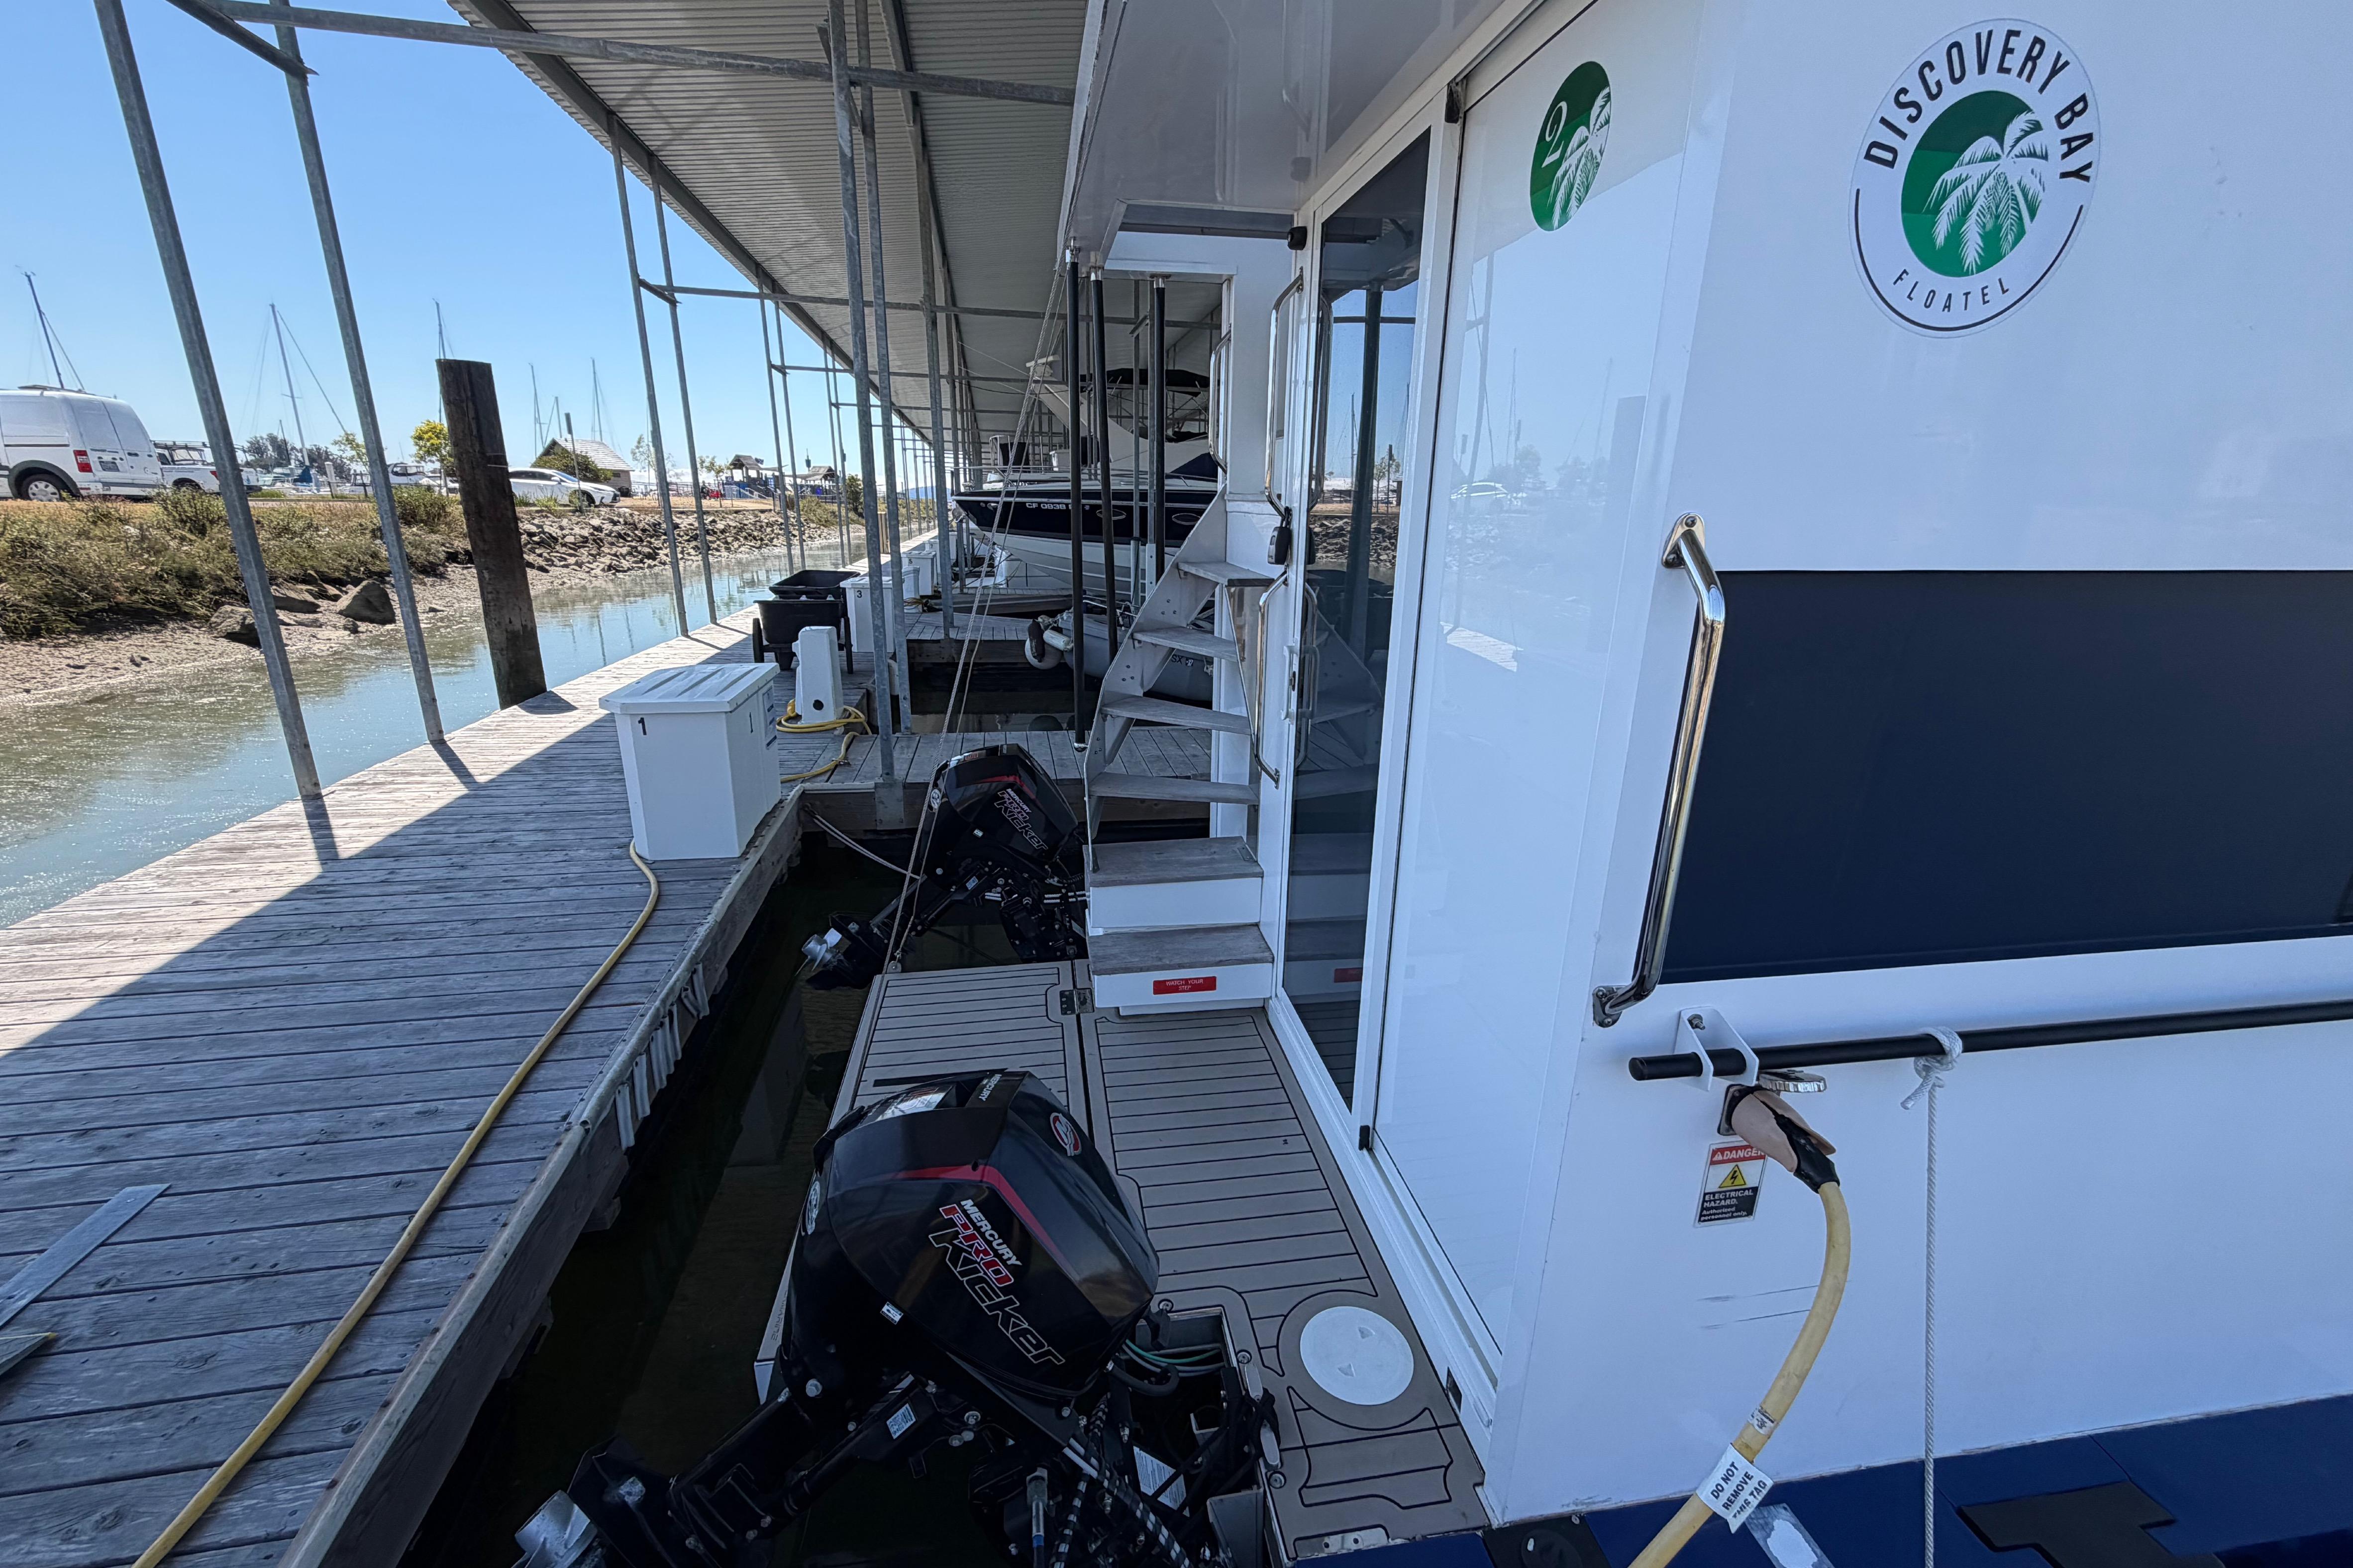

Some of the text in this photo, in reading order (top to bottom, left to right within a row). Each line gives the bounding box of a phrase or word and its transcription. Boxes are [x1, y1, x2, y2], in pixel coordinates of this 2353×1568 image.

[1863, 29, 2094, 183] DISCOVERY BAY
[1893, 269, 2009, 312] FLOATEL
[638, 717, 647, 735] 1
[1006, 788, 1031, 812] MERCURY
[978, 1074, 1002, 1101] MERCURY
[1705, 1189, 1753, 1200] ELECTRICAL
[939, 1204, 1014, 1287] PRO
[960, 1199, 1023, 1267] MERCURY
[1710, 1461, 1739, 1500] DO NOT
[1722, 1471, 1754, 1511] REMOVE
[1732, 1479, 1767, 1519] THIS TAG
